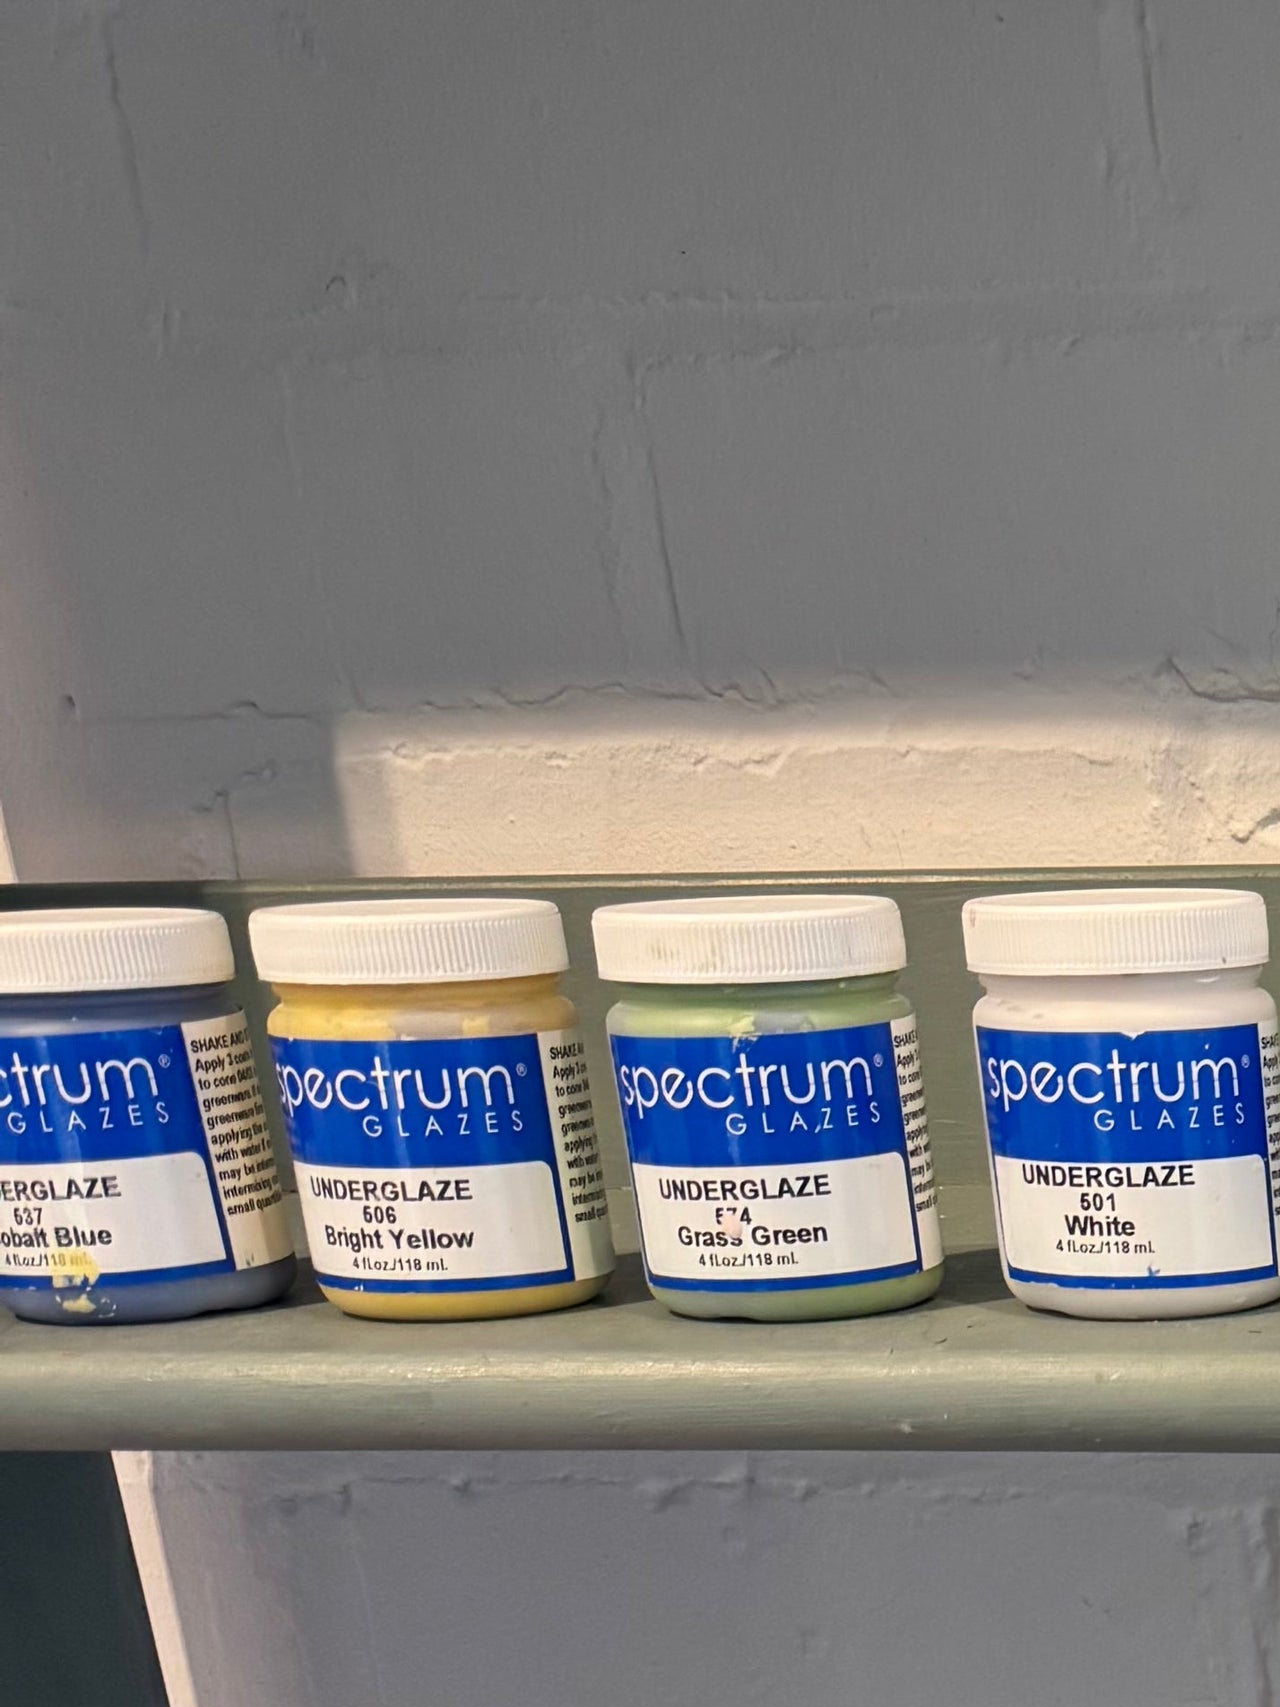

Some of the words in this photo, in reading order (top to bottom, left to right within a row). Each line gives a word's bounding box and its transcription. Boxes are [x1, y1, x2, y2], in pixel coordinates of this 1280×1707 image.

[191, 1034, 229, 1053] SHAKE
[195, 1053, 225, 1073] Apply
[198, 1077, 211, 1091] to
[276, 1056, 515, 1116] spectrum
[620, 1053, 874, 1119] spectrum
[988, 1049, 1240, 1112] spectrum
[8, 1102, 169, 1133] GLAZES
[363, 1110, 523, 1137] GLAZES
[726, 1101, 880, 1135] GLAZES
[1094, 1102, 1245, 1131] GLAZES
[215, 1147, 238, 1164] with
[219, 1168, 241, 1182] may
[1022, 1164, 1195, 1188] UNDERGLAZE
[0, 1176, 122, 1201] ERGLAZE
[310, 1176, 473, 1202] UNDERGLAZE
[659, 1174, 832, 1202] UNDERGLAZE
[1080, 1193, 1116, 1212] 501
[0, 1227, 49, 1248] obalt
[54, 1226, 112, 1247] Blue
[678, 1226, 743, 1248] Grass
[752, 1225, 828, 1246] Green
[1065, 1214, 1136, 1237] White
[324, 1225, 384, 1253] Bright
[392, 1228, 474, 1250] Yellow
[1056, 1239, 1063, 1252] 4
[352, 1257, 359, 1269] 4
[699, 1253, 706, 1266] 4
